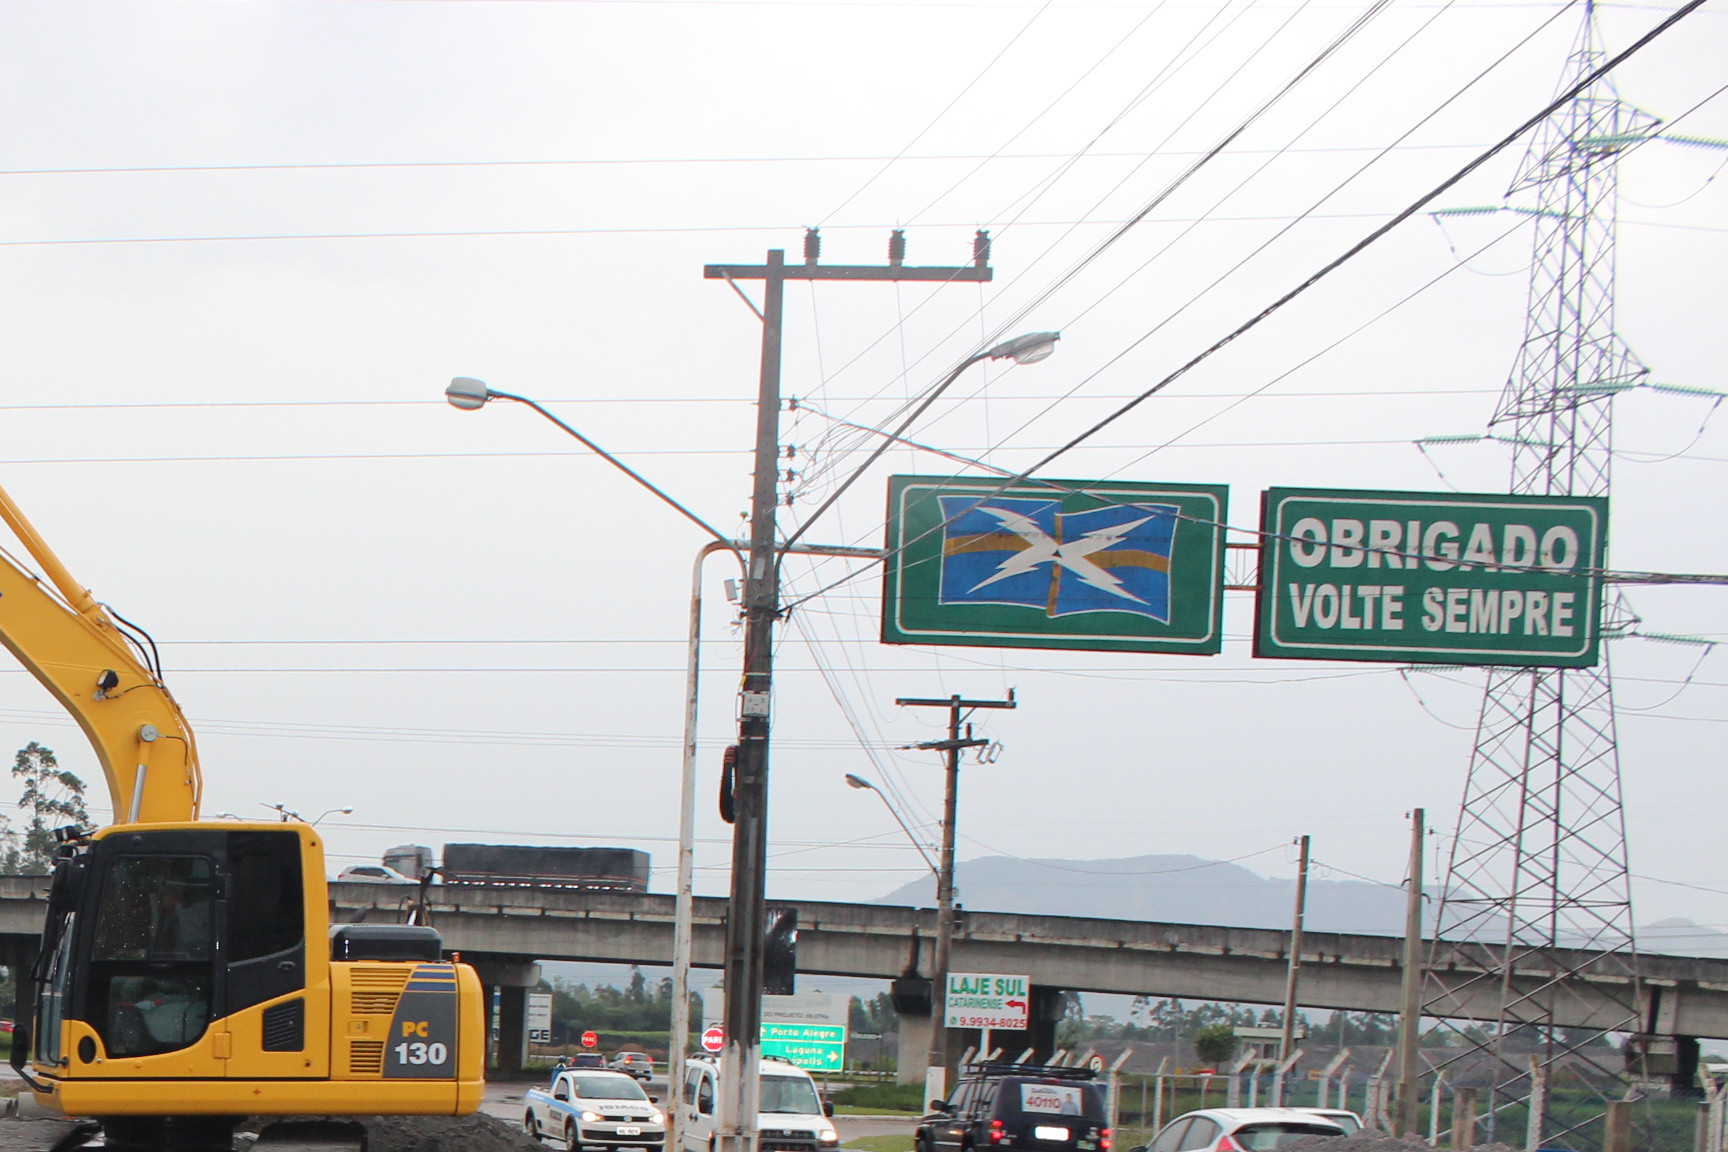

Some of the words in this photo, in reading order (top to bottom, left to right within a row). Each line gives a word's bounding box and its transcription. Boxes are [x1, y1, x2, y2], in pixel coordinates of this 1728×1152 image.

[1289, 517, 1579, 574] OBRIGADO
[1289, 582, 1404, 630] VOLTE
[1422, 587, 1575, 637] SEMPRE
[950, 977, 990, 995] LAJE
[994, 978, 1026, 996] SUL
[949, 997, 1003, 1009] CATARINENSE
[402, 1021, 429, 1037] PC
[959, 1016, 1026, 1028] 9.9934-8025
[771, 1027, 800, 1036] Porto
[803, 1029, 836, 1039] Alegre
[395, 1042, 447, 1065] 130
[786, 1046, 824, 1055] Laguna
[1026, 1096, 1061, 1109] 40110
